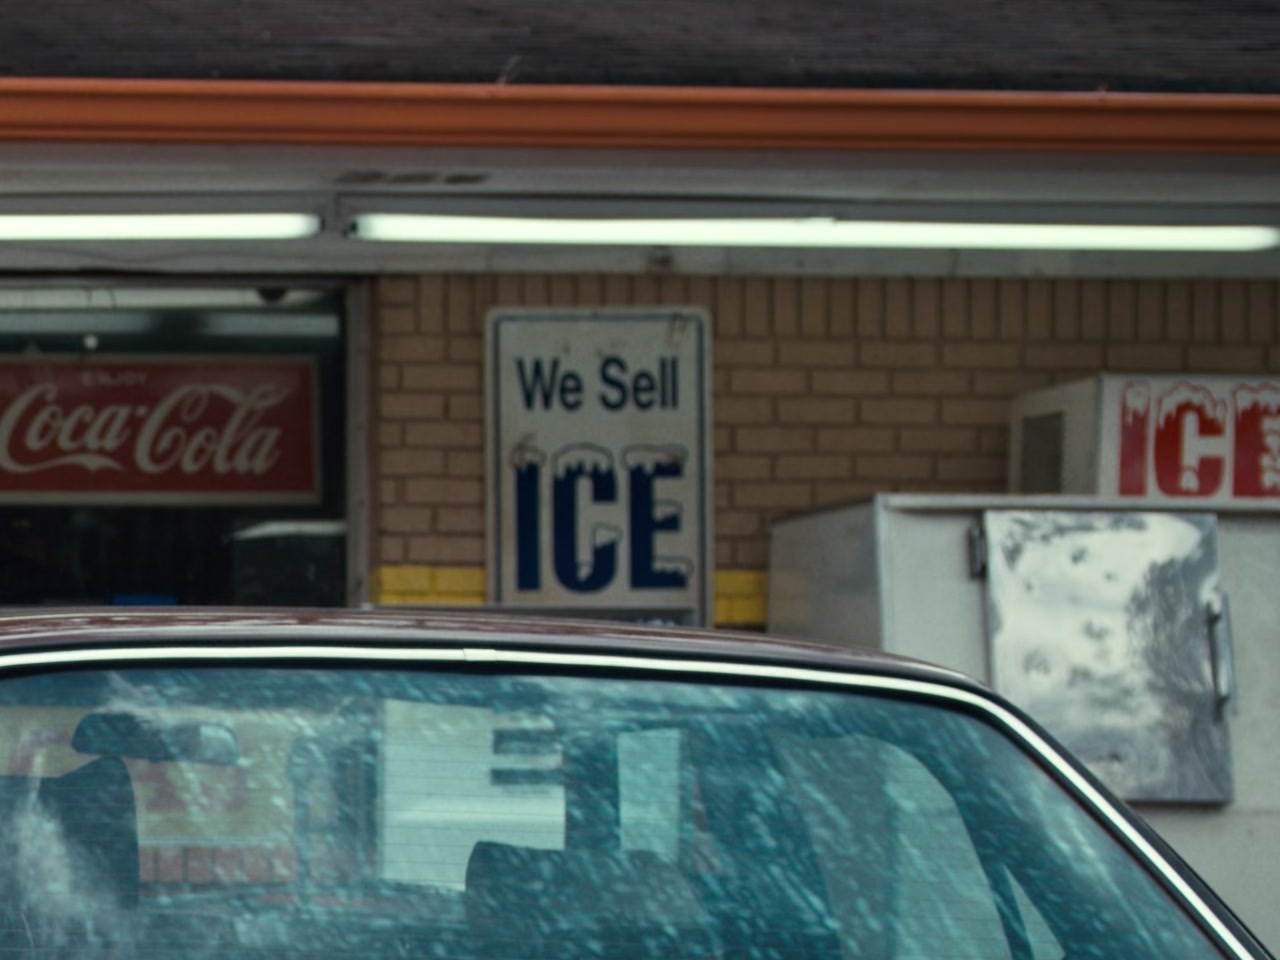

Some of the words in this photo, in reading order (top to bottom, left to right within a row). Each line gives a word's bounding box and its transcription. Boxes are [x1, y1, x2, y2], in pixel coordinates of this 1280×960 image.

[80, 371, 147, 387] ENJOY
[515, 356, 583, 412] We
[600, 354, 679, 412] Sell
[1118, 380, 1280, 498] ICE
[511, 442, 693, 594] ICE
